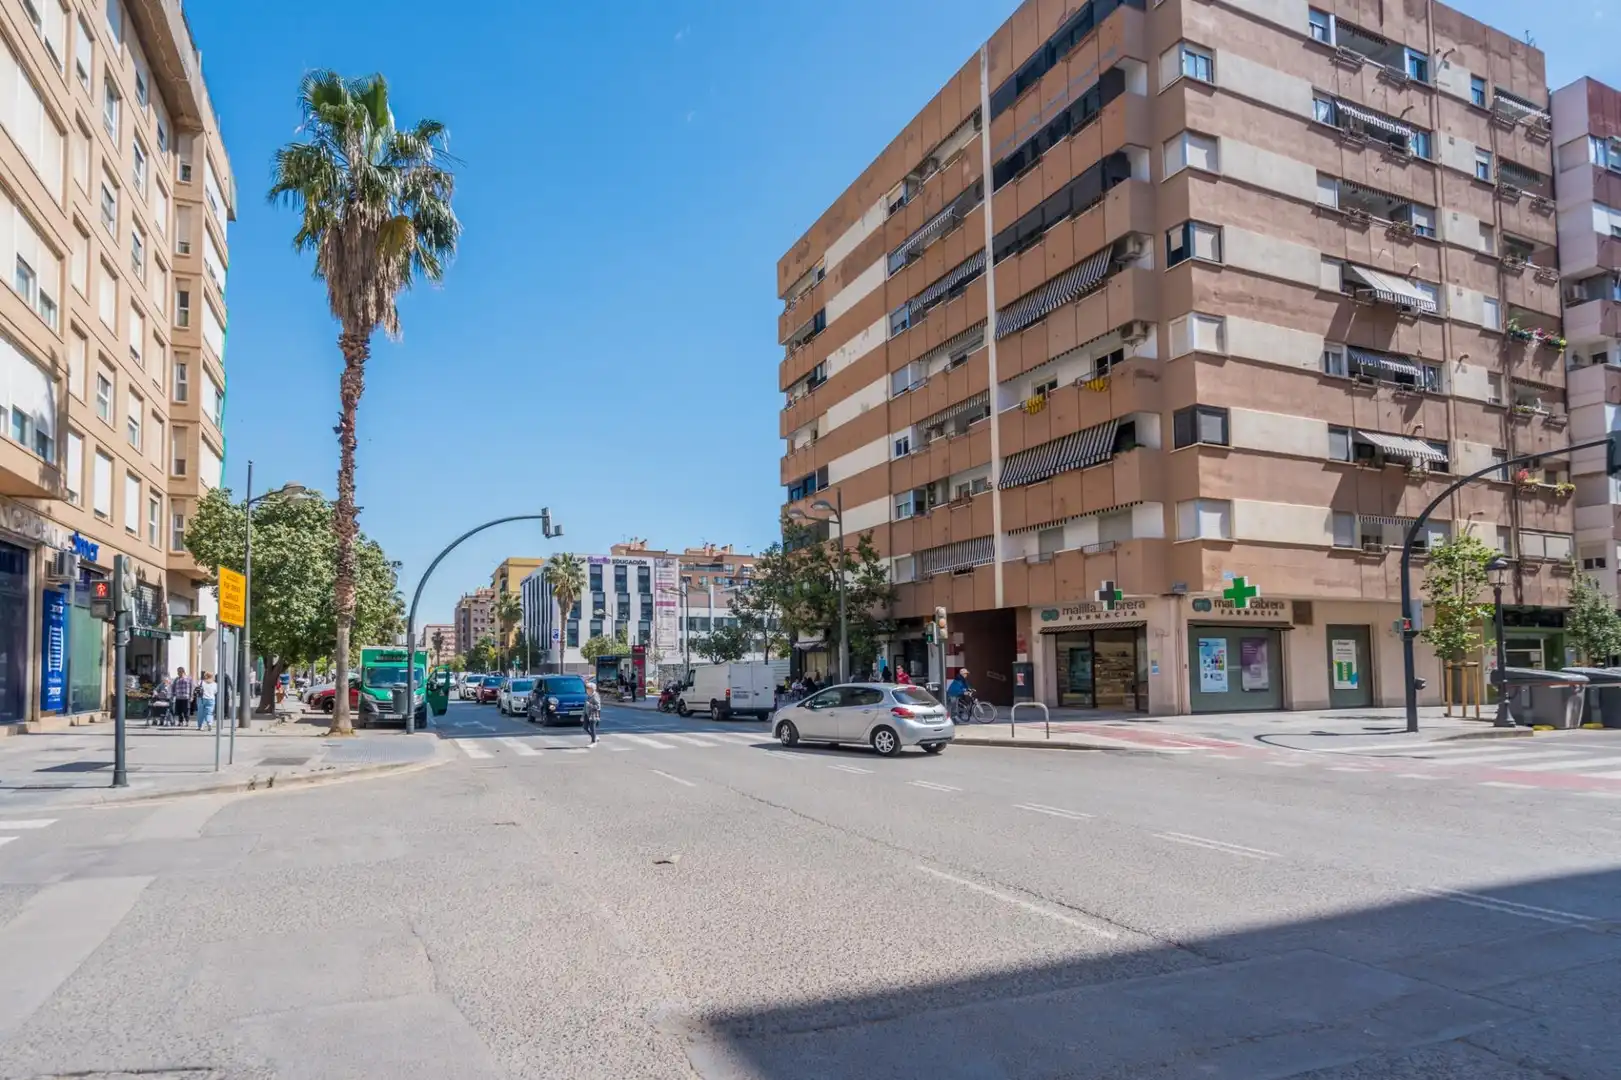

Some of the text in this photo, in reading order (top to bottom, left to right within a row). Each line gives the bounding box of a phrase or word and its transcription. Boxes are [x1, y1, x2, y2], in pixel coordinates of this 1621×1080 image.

[1115, 600, 1146, 610] brera
[1250, 597, 1284, 609] cabrera
[1069, 611, 1137, 621] FARMACIA
